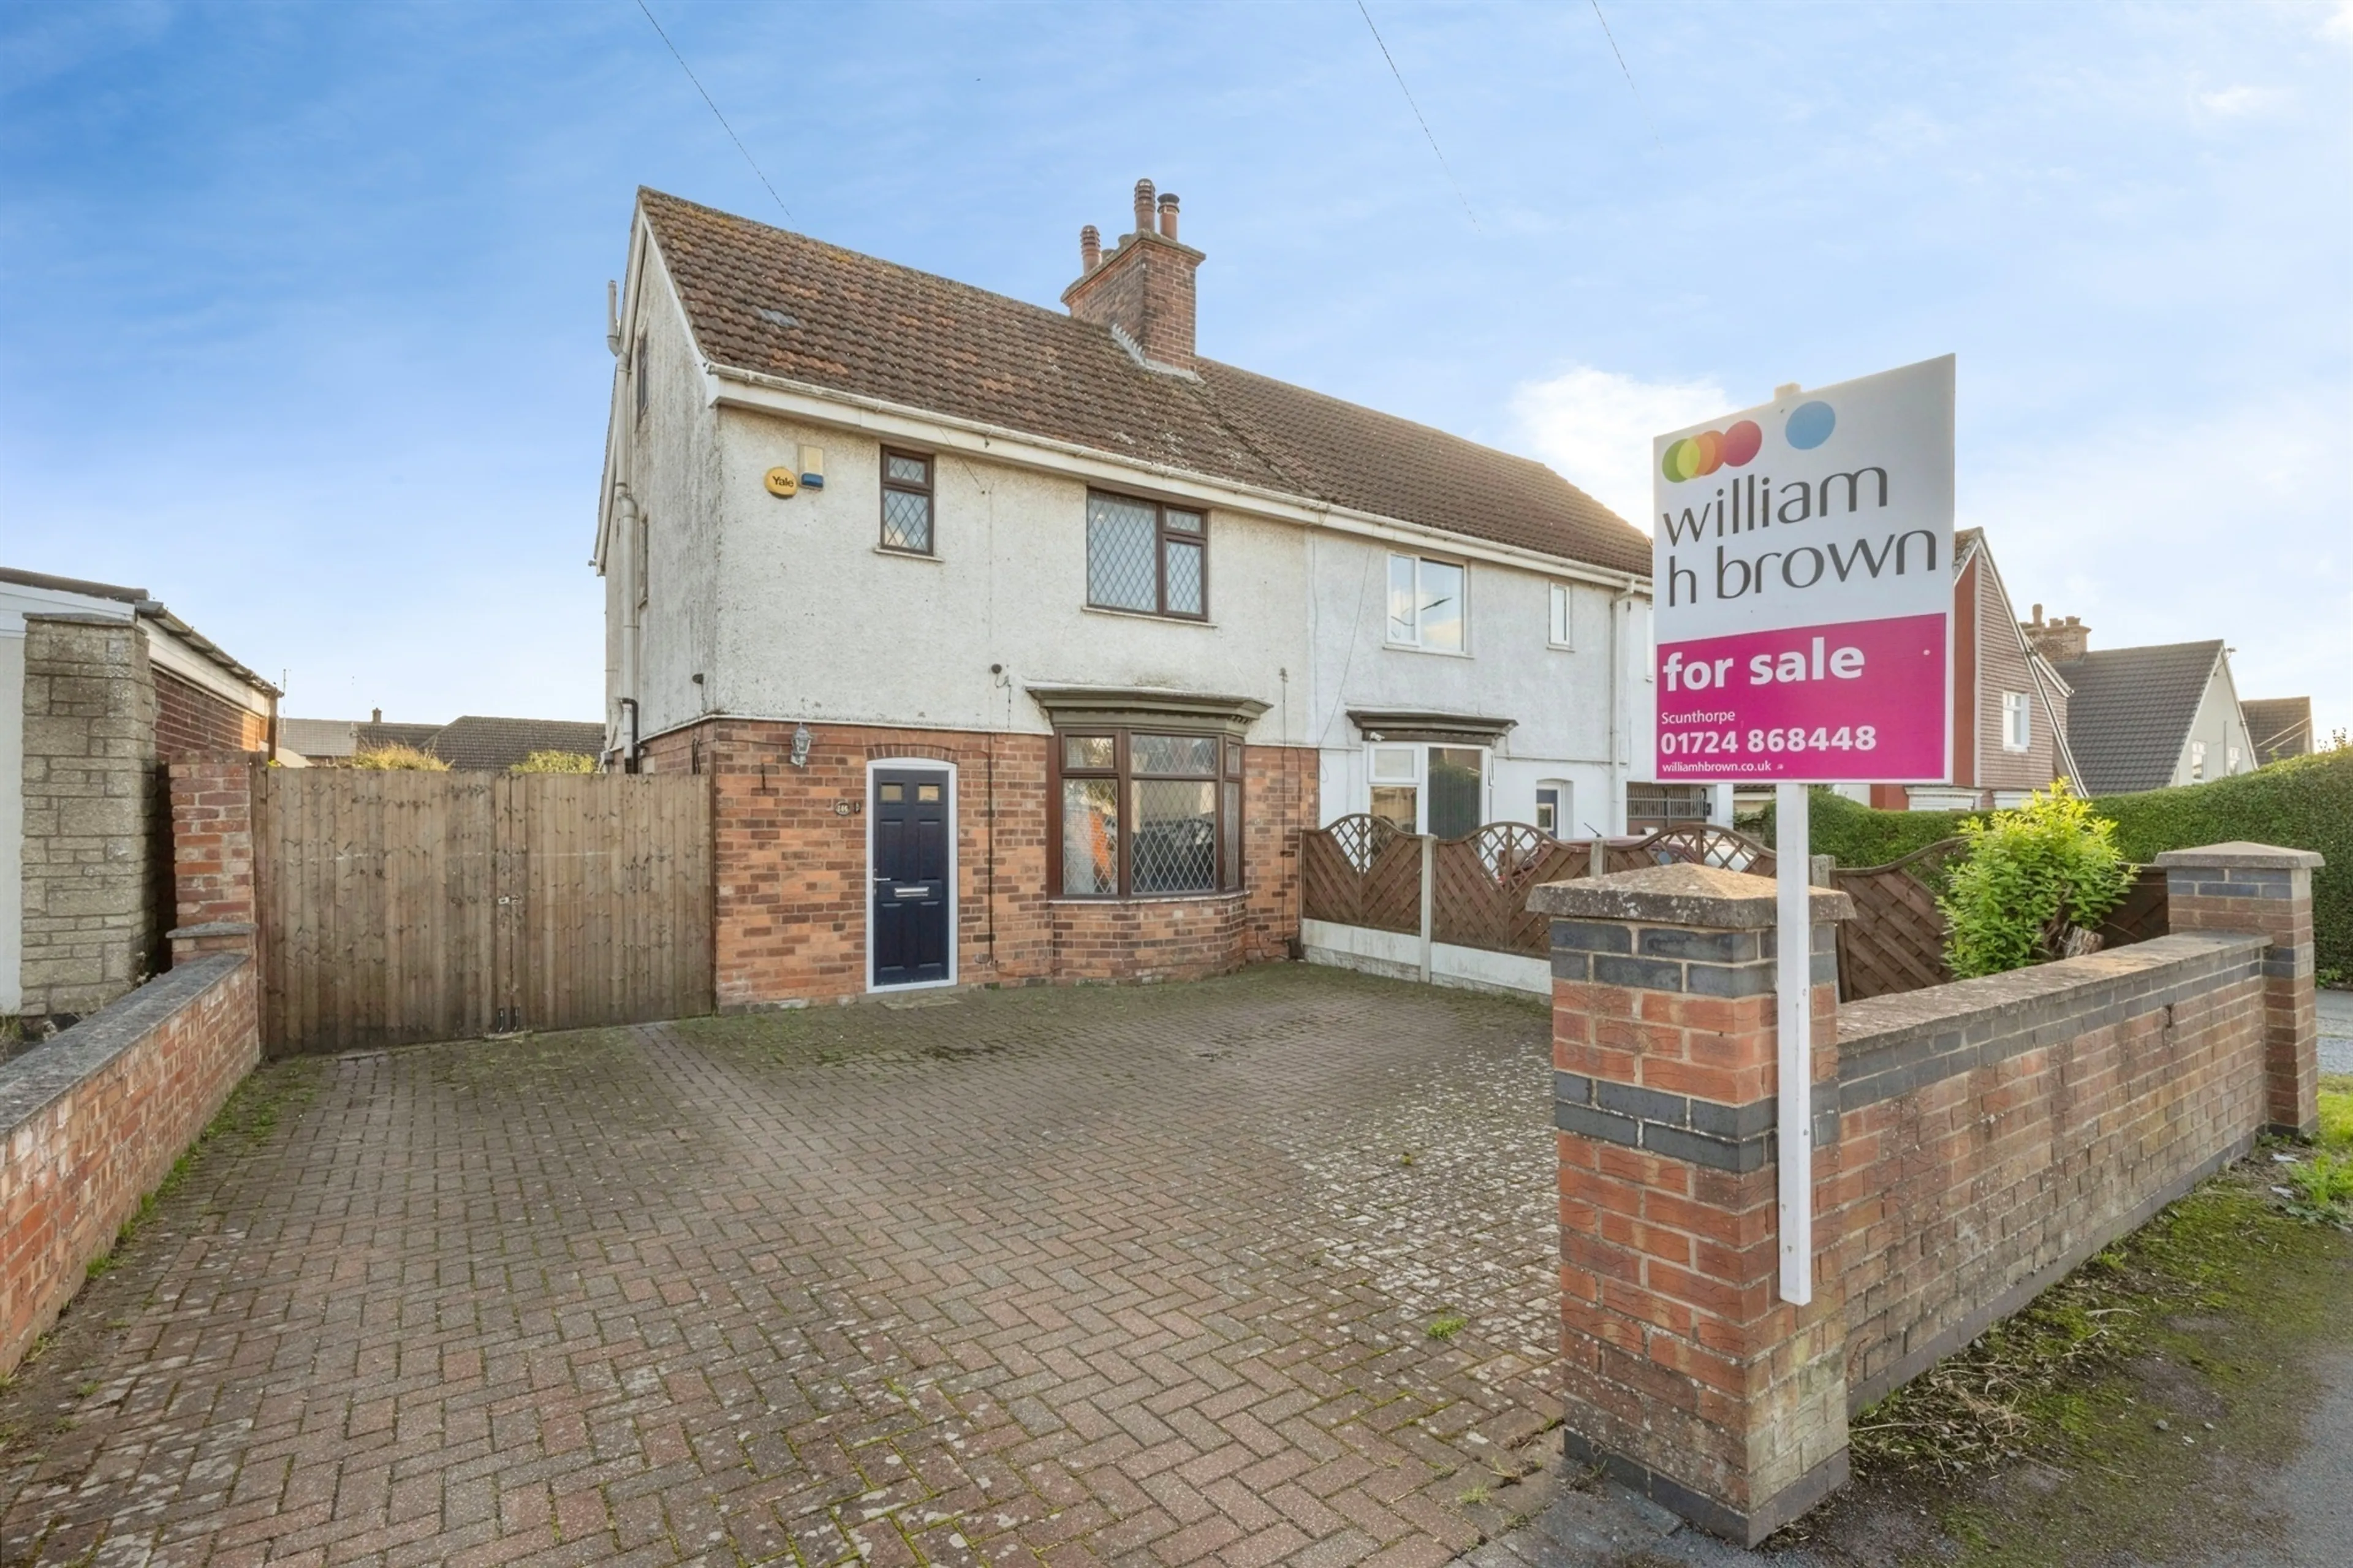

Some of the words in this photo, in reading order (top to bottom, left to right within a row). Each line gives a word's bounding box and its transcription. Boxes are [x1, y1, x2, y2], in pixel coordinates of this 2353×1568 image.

[773, 476, 794, 487] Yale
[1663, 466, 1887, 547] william
[1669, 556, 1697, 607] h
[1717, 529, 1937, 599] brown
[1663, 652, 1733, 692] for
[1749, 637, 1865, 685] sale
[1661, 710, 1735, 725] Scunthorpe
[1661, 732, 1738, 754] 01724
[1747, 725, 1876, 752] 868448
[1662, 760, 1771, 772] williamhbrown.co.uk
